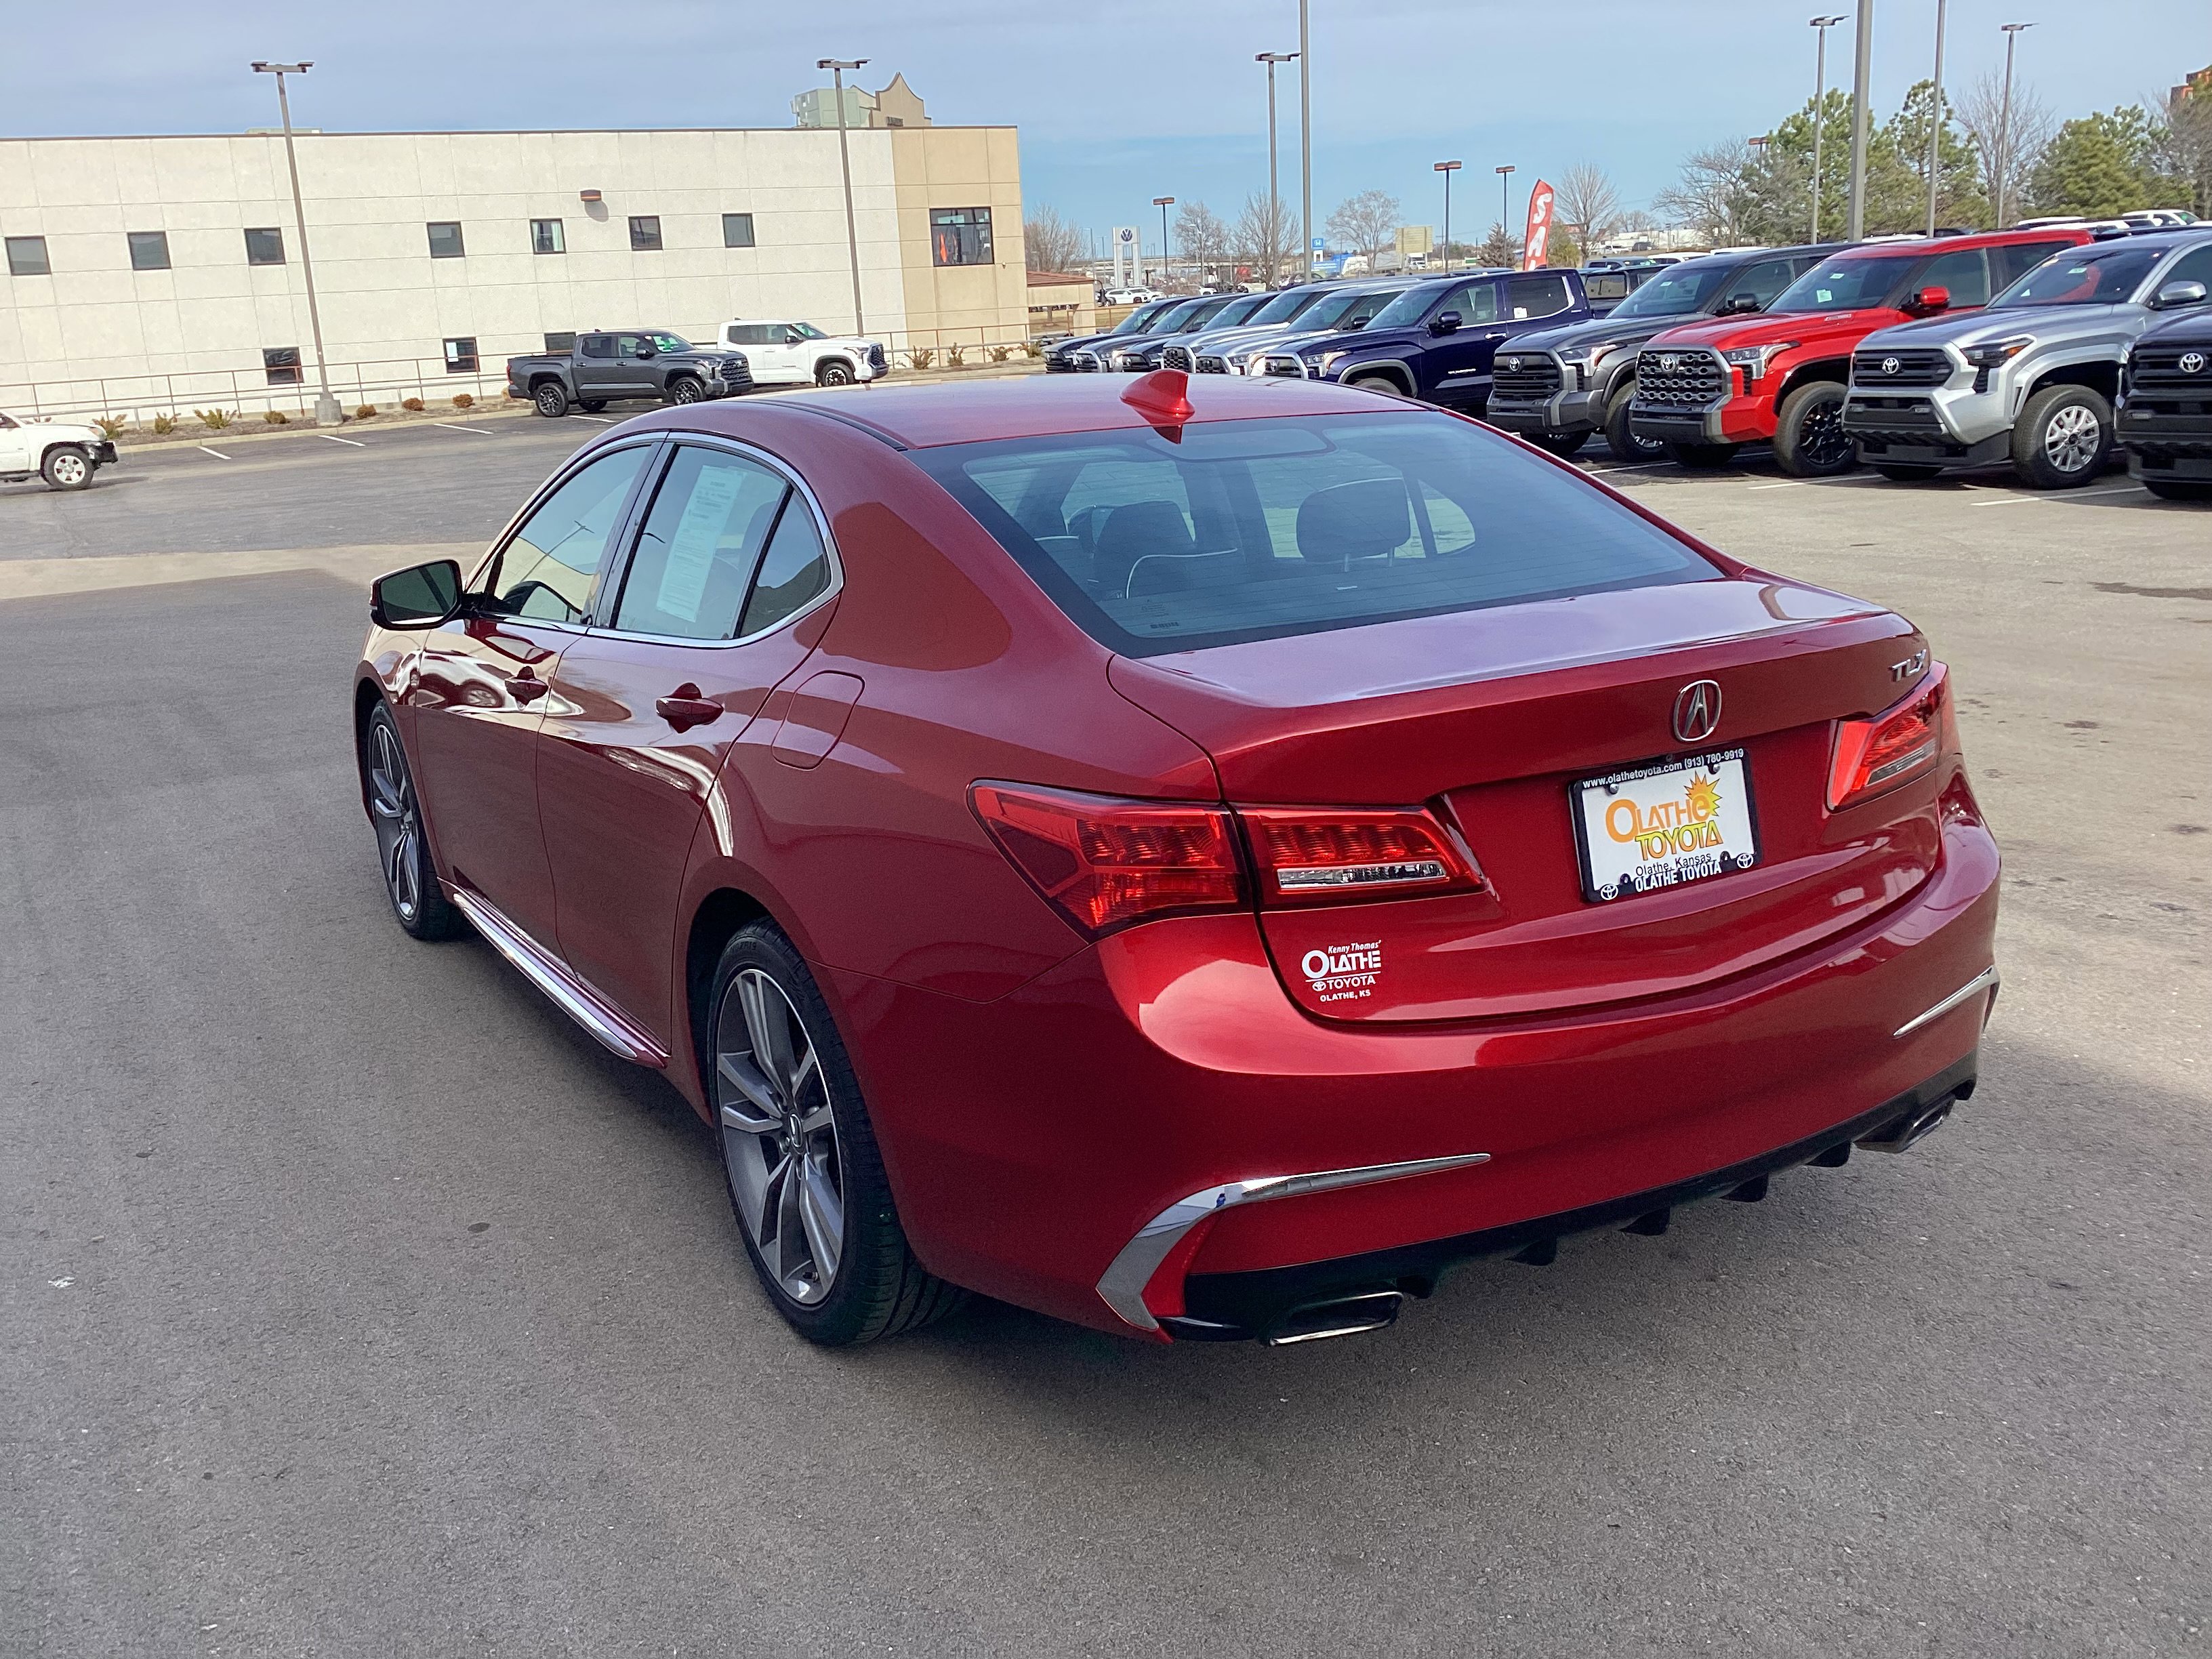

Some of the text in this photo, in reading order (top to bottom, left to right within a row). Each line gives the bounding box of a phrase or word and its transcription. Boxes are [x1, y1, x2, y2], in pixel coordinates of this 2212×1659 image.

[1891, 649, 1926, 682] TLX
[1582, 748, 1744, 789] www.olathetoyota.com (913) 780-9919
[1635, 820, 1723, 861] TOYOTA
[1675, 853, 1711, 867] Kansas
[1635, 859, 1721, 892] OLATHE TOYOTA
[1328, 945, 1350, 954] Kenny
[1301, 950, 1381, 979] OLATHE
[1320, 991, 1357, 1002] OLATHE,
[1326, 975, 1376, 990] TOYOTA
